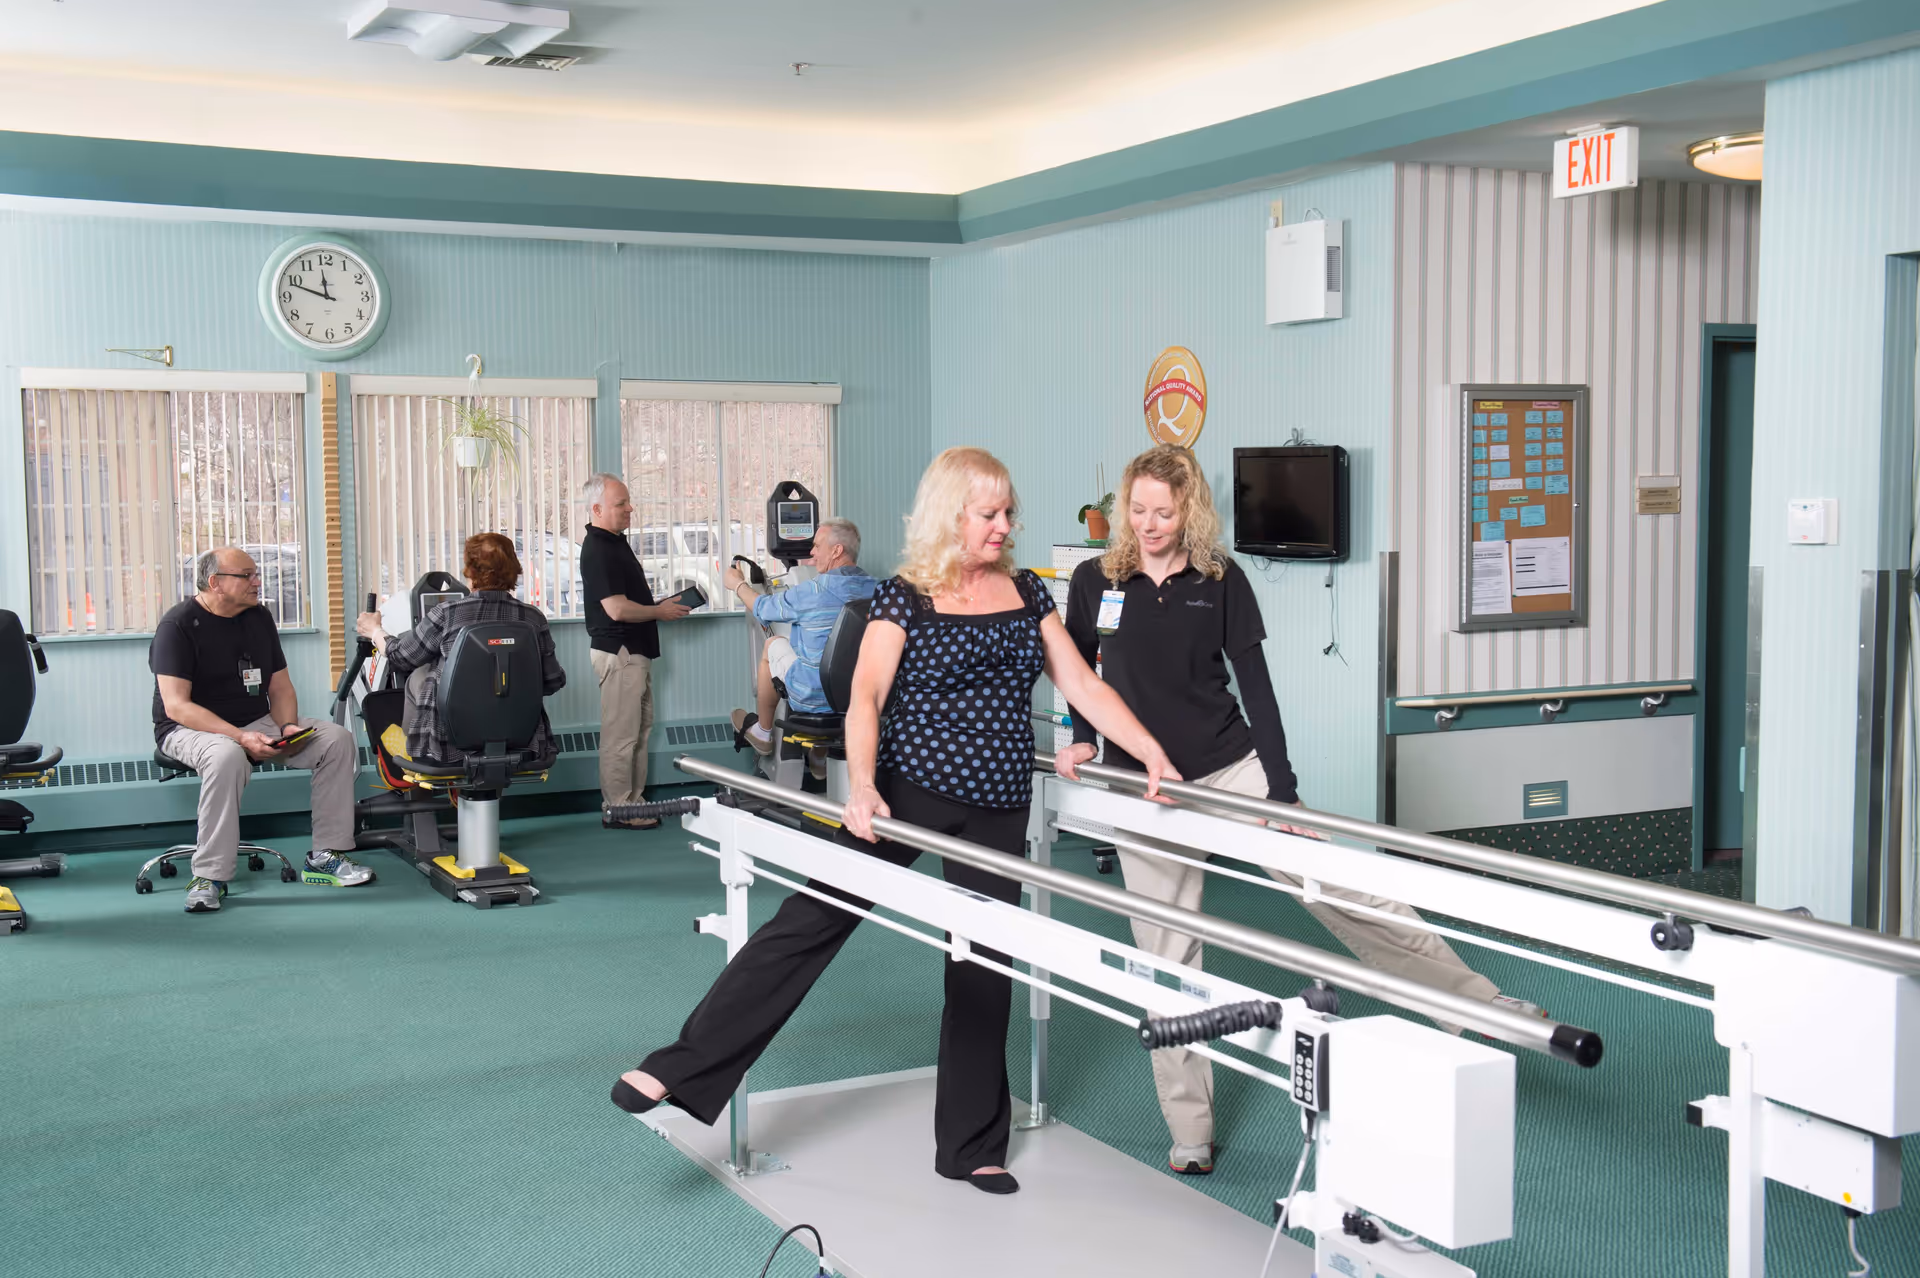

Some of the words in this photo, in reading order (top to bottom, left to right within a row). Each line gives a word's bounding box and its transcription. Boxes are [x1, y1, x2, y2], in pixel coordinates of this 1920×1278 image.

[1568, 132, 1615, 188] EXIT
[300, 259, 314, 272] 11
[318, 253, 334, 266] 12
[341, 259, 347, 272] 1
[289, 274, 303, 286] 10
[354, 273, 364, 285] 2
[282, 290, 292, 303] 9
[361, 290, 370, 302] 3
[290, 308, 300, 321] 8
[356, 308, 365, 320] 4
[305, 322, 314, 335] 7
[325, 328, 334, 340] 6
[343, 322, 353, 335] 5
[1145, 385, 1166, 407] NATIONAL
[1165, 381, 1186, 390] QUALITY
[1185, 385, 1202, 403] AWARD
